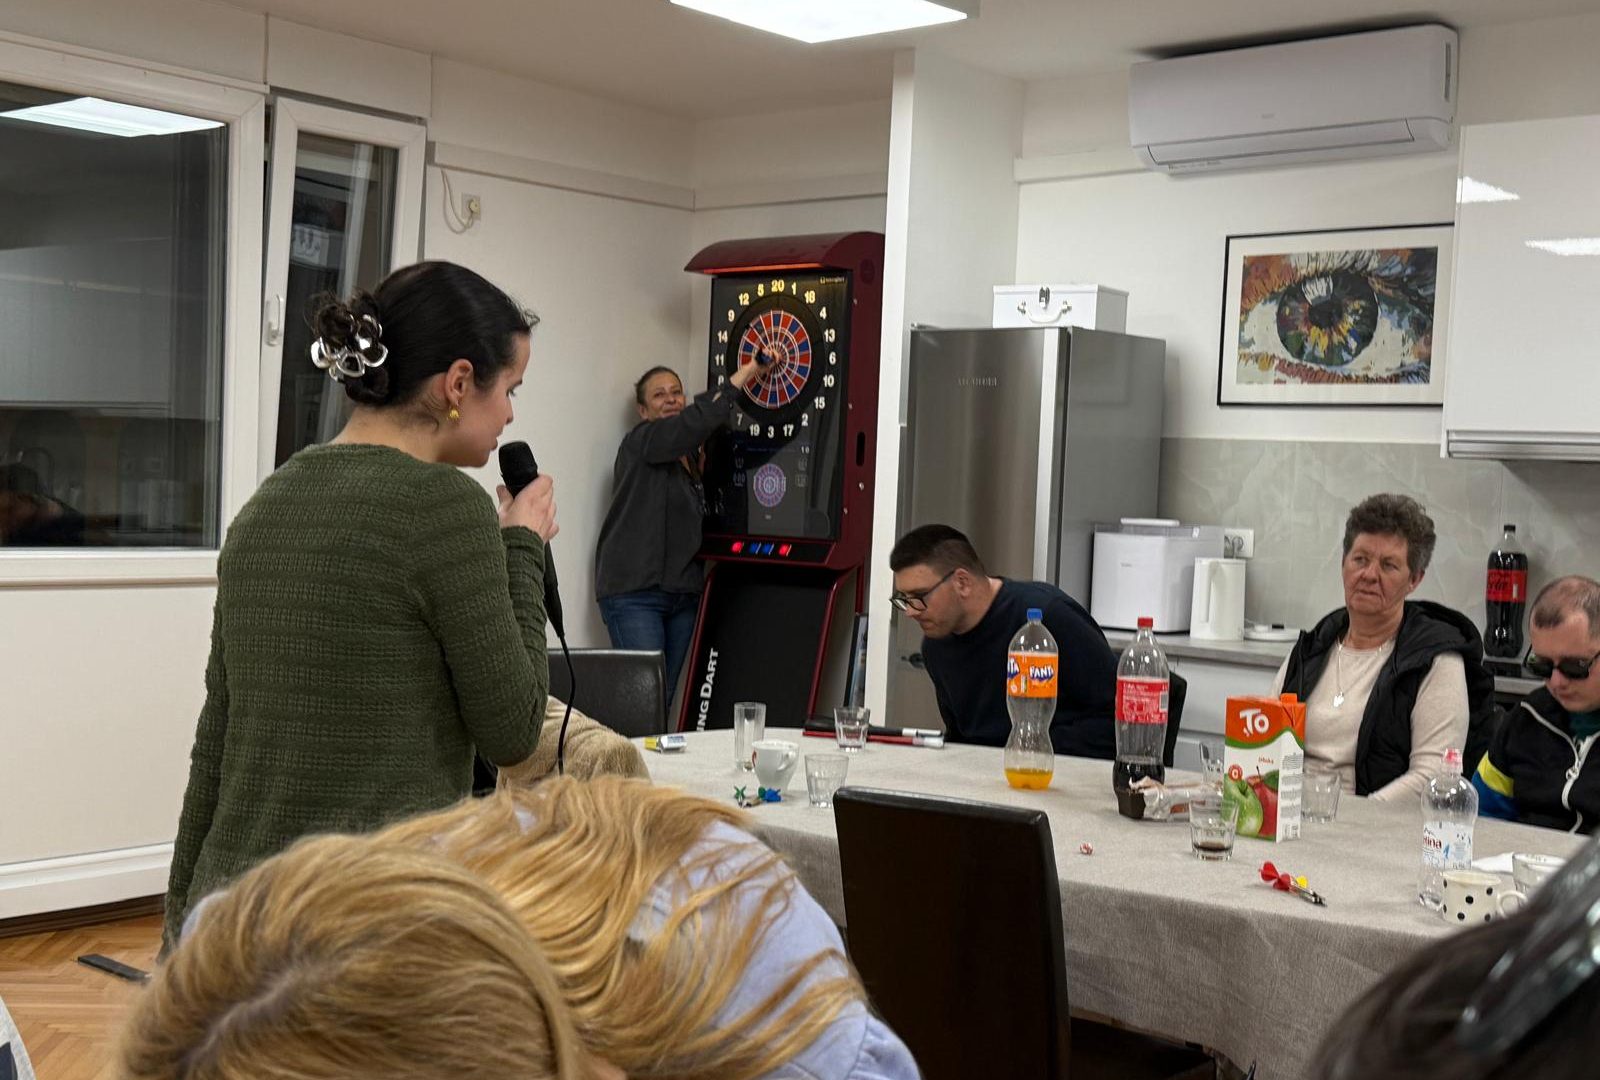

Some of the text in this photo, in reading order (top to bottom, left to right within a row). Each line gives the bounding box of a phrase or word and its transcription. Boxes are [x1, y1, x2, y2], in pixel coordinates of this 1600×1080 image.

[757, 283, 765, 297] 5
[771, 279, 785, 293] 20
[791, 281, 797, 296] 1
[738, 292, 750, 306] 12
[804, 290, 816, 304] 18
[727, 309, 735, 322] 9
[819, 306, 827, 320] 4
[717, 330, 728, 344] 14
[824, 328, 836, 343] 13
[714, 353, 725, 366] 11
[828, 351, 837, 365] 6
[822, 374, 835, 388] 10
[814, 396, 826, 409] 15
[736, 413, 743, 426] 7
[801, 413, 809, 427] 2
[749, 423, 761, 437] 19
[767, 425, 775, 439] 3
[782, 424, 794, 437] 17
[1029, 664, 1054, 679] FANT
[696, 647, 719, 732] INGDART
